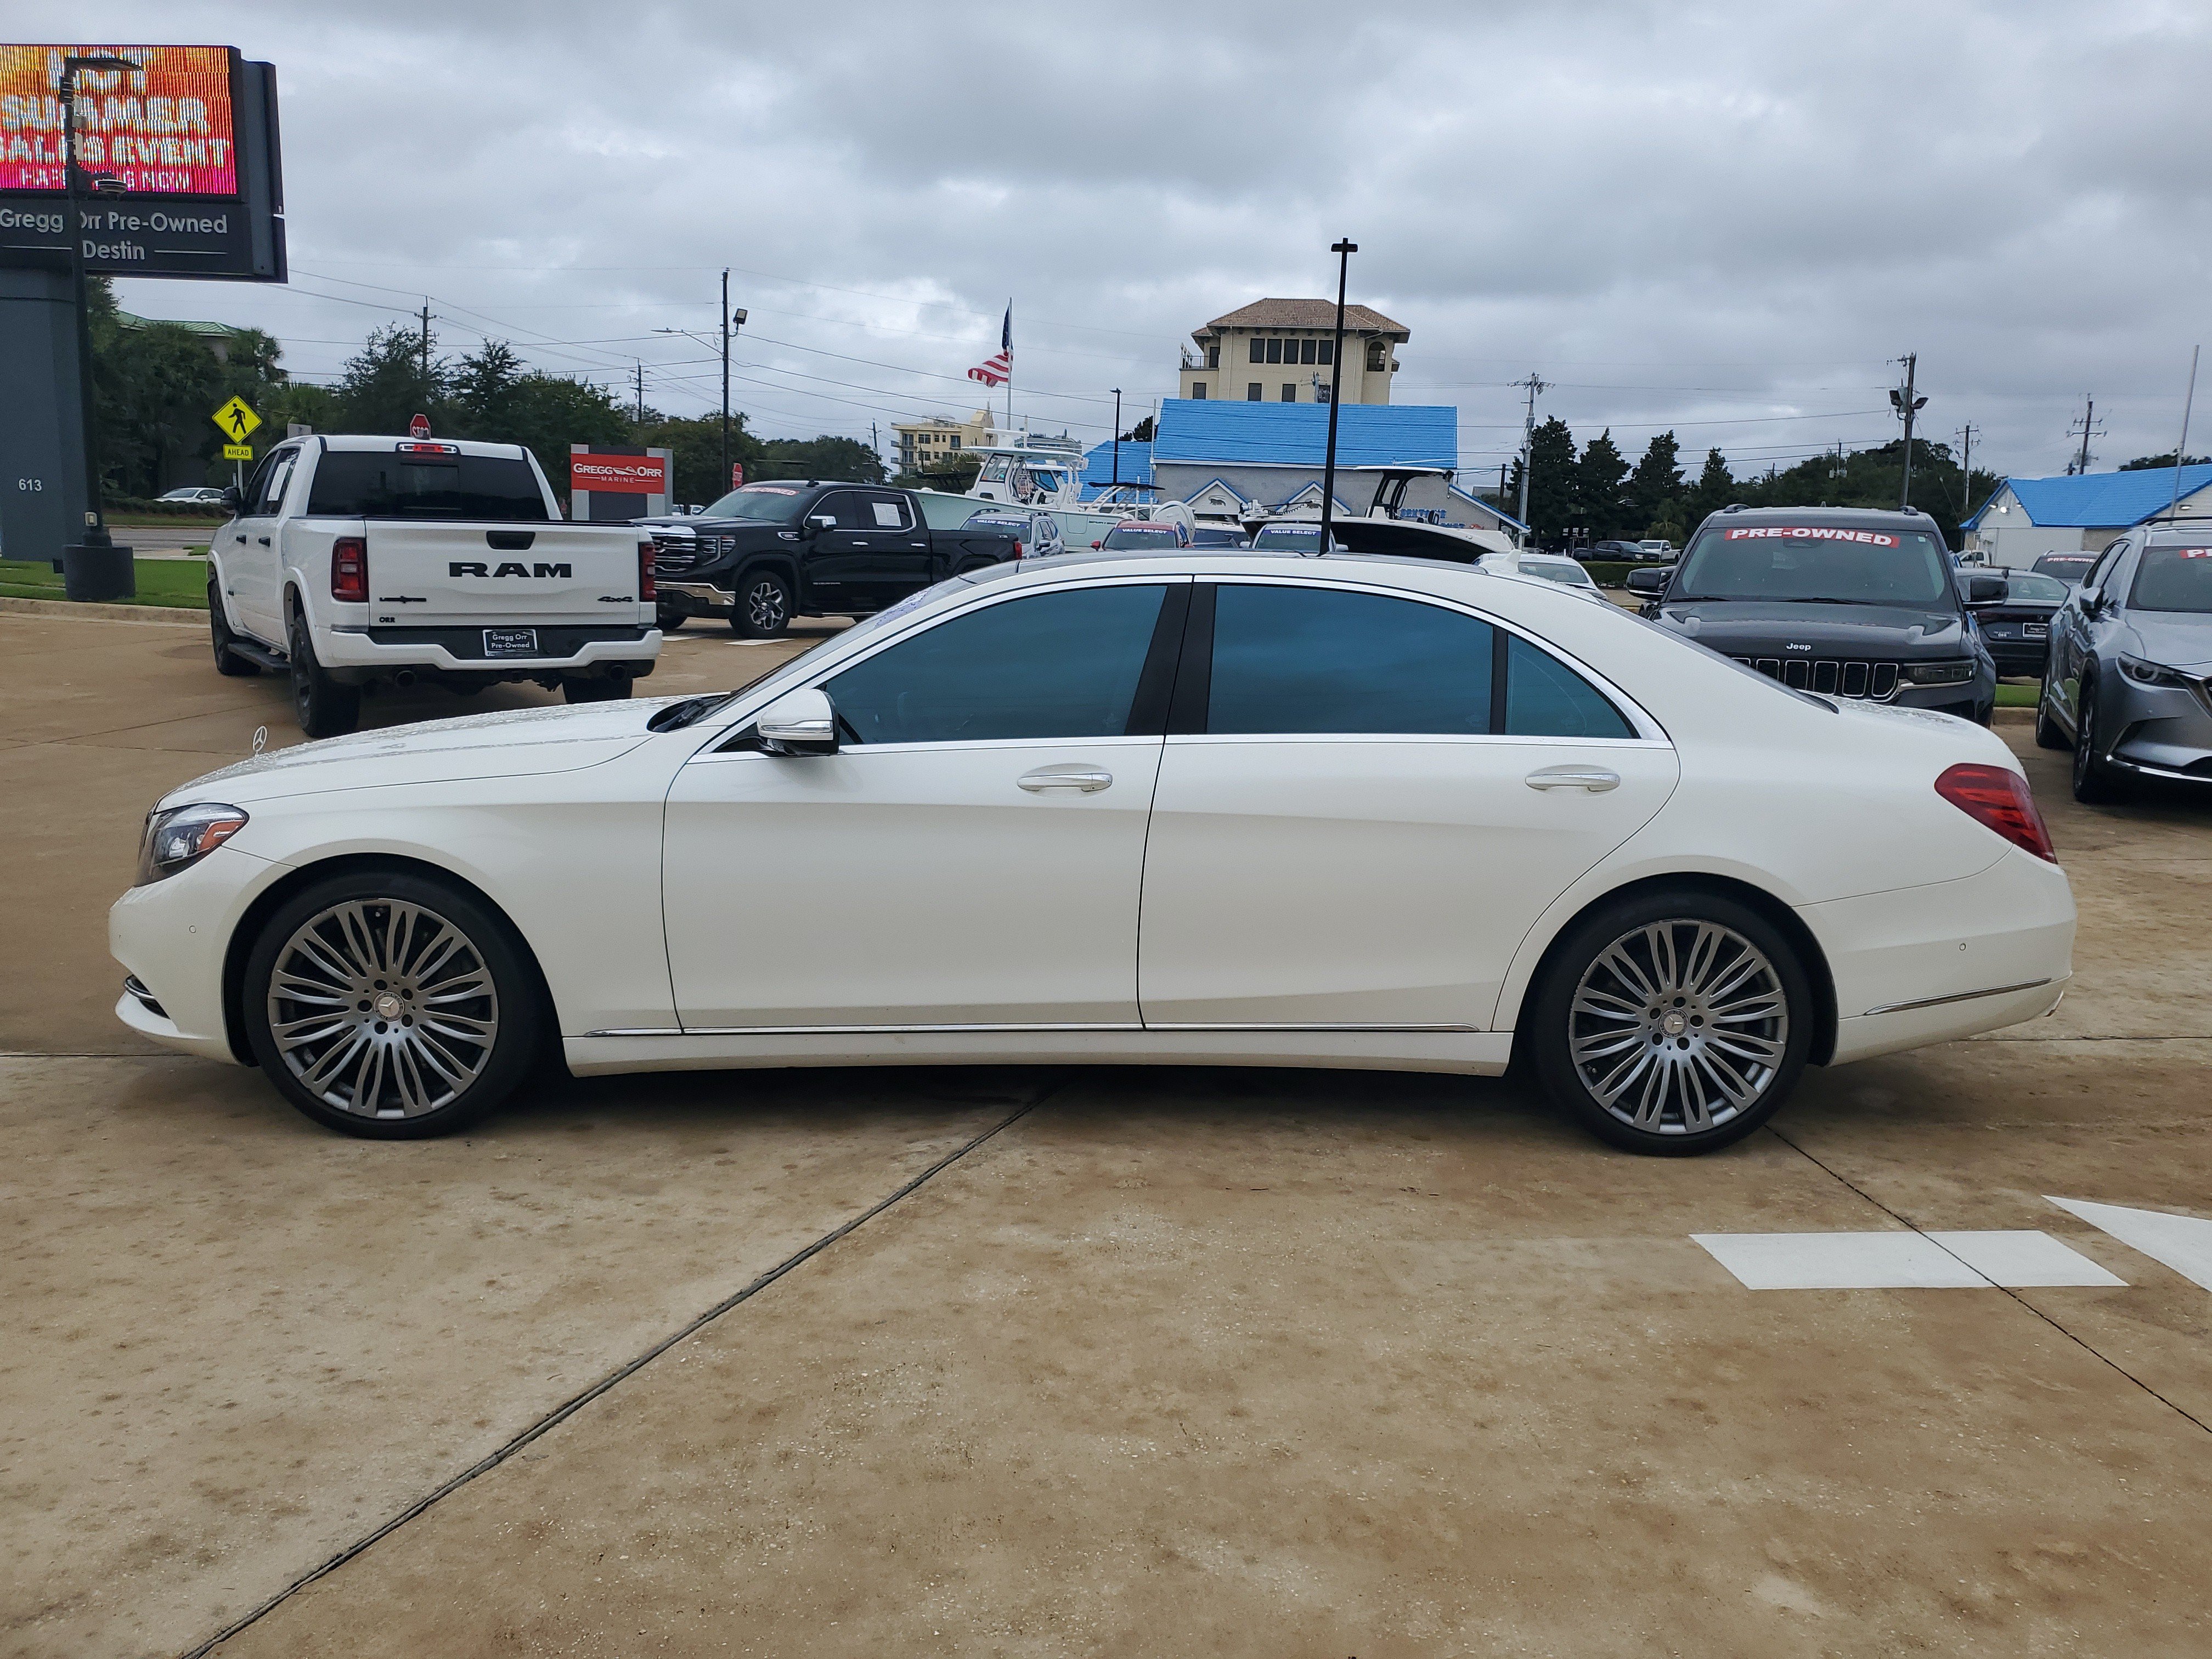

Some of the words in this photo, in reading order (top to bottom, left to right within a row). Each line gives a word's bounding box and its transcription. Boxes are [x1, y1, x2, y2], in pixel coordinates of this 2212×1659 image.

[111, 136, 230, 167] EVENT
[0, 208, 63, 233] Gregg
[108, 211, 228, 234] Pre-Owned
[82, 239, 145, 259] Destin
[227, 448, 250, 457] AHEAD
[18, 478, 42, 492] 613
[1731, 528, 1892, 546] PRE-OWNED
[449, 561, 572, 578] RAM
[1786, 642, 1812, 651] Jeep
